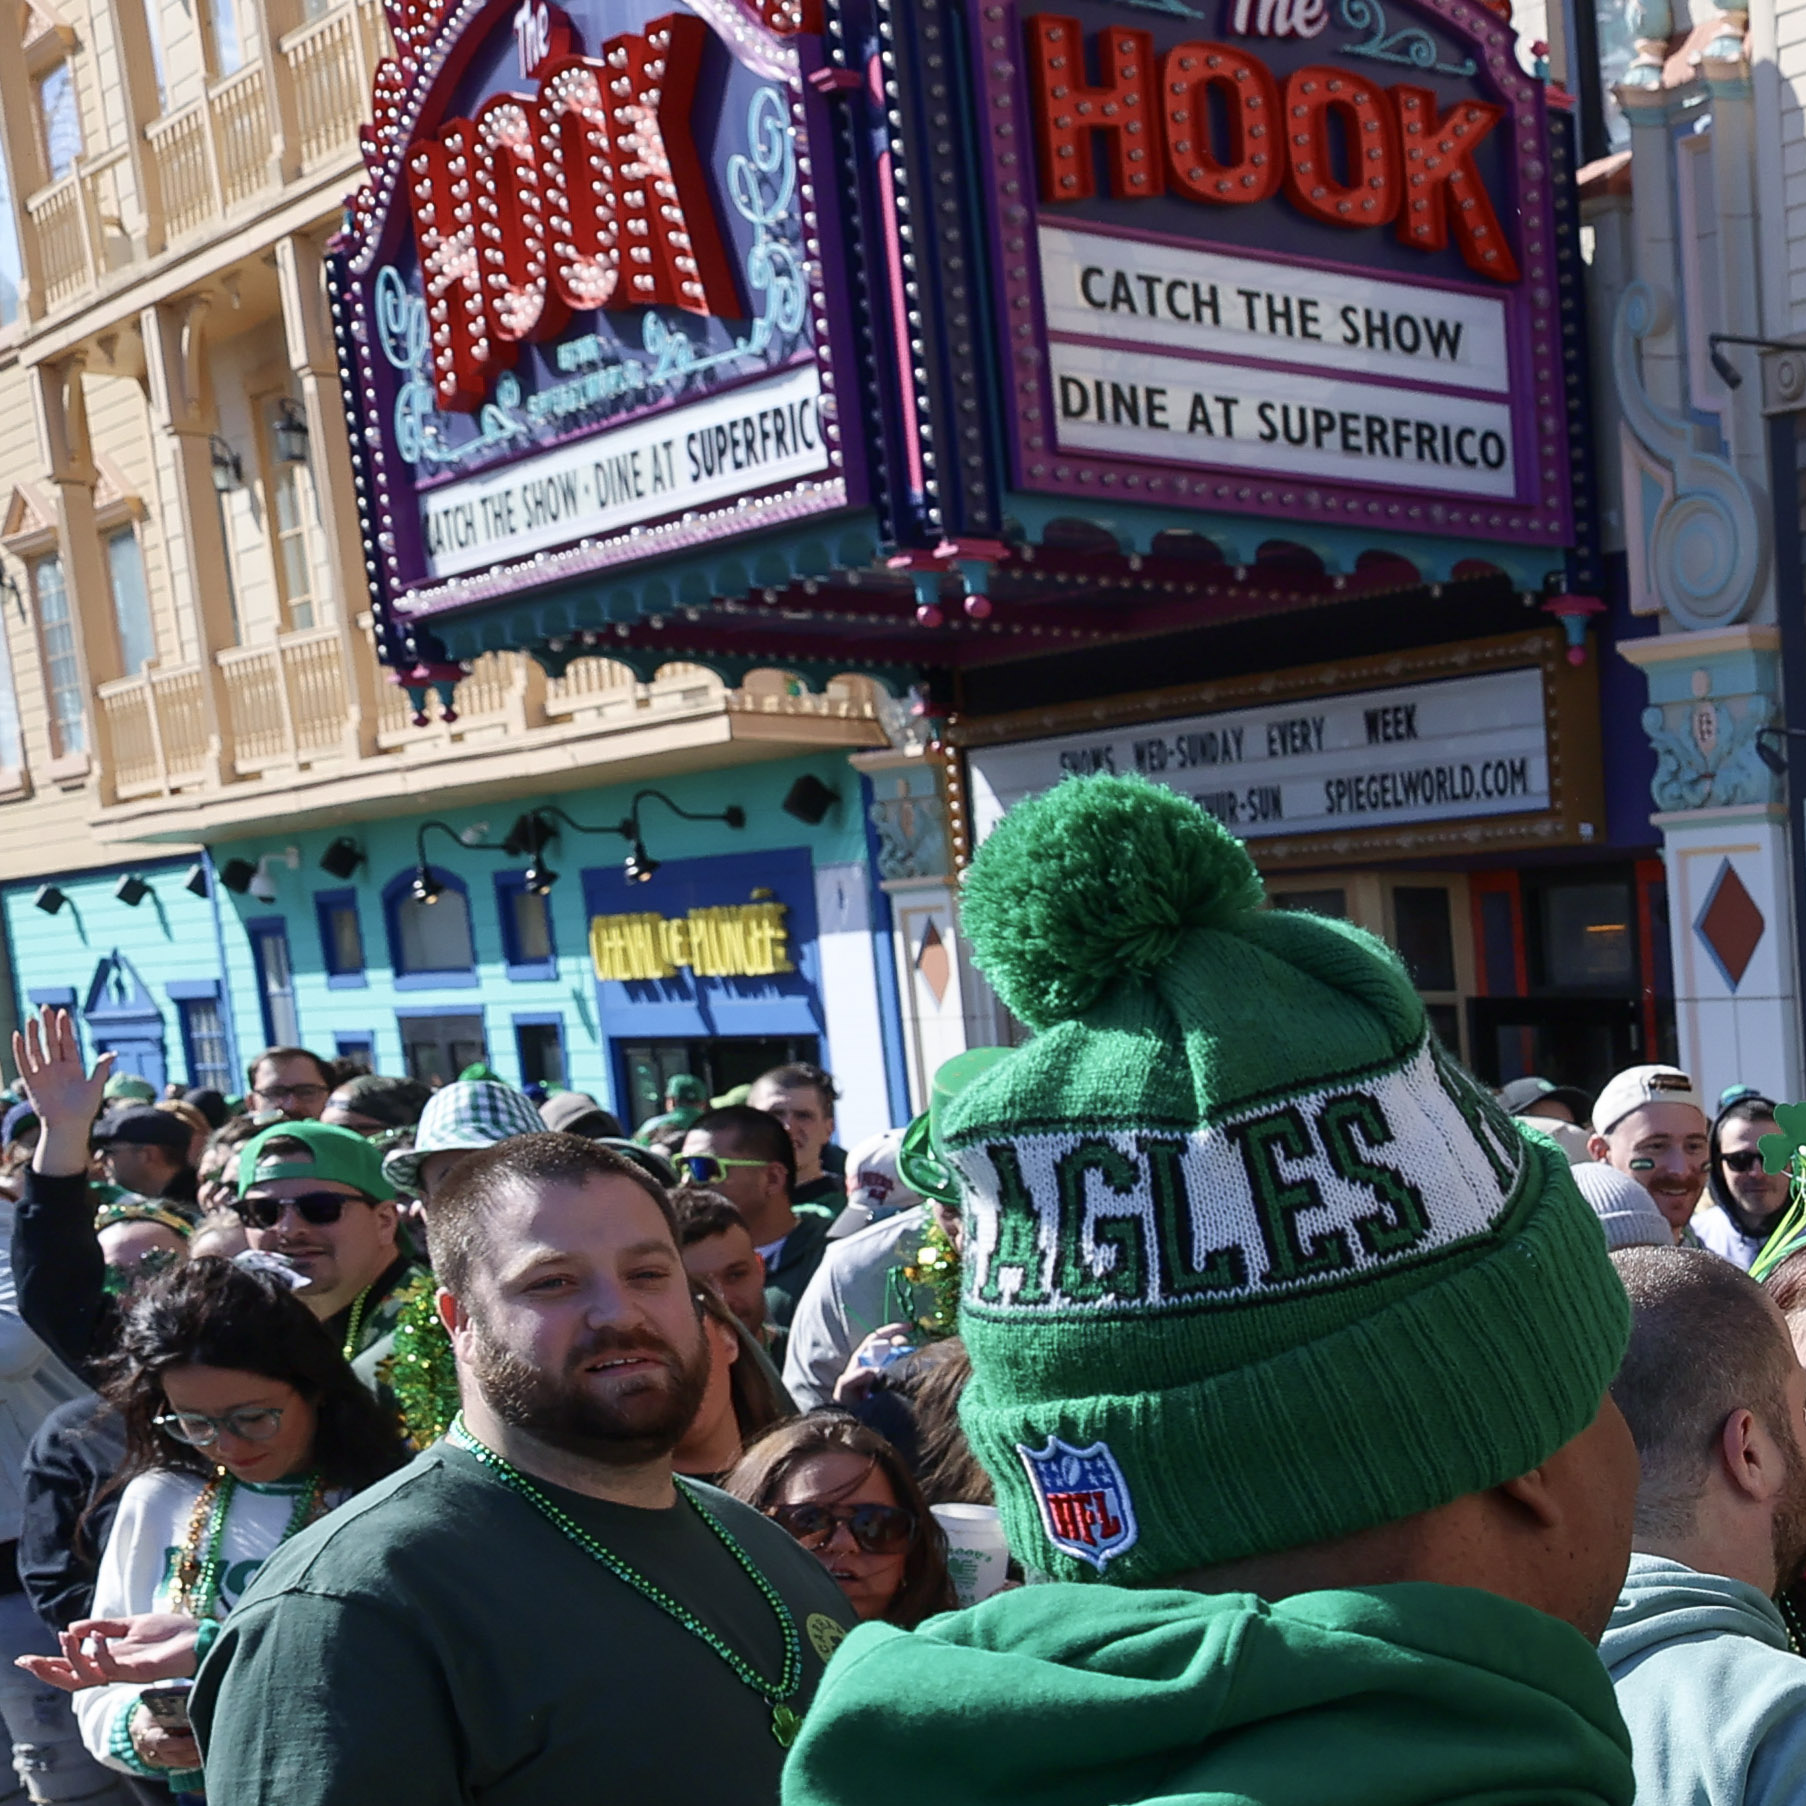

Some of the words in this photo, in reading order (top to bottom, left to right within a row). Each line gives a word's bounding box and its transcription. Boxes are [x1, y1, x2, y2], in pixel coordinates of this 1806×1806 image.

[1027, 13, 1520, 282] HOOK
[406, 14, 712, 411] HOOK
[1079, 266, 1221, 329] CATCH
[1236, 289, 1320, 342] THE
[1341, 305, 1465, 362] SHOW
[1059, 375, 1170, 431] DINE
[1187, 394, 1240, 438] AT
[1258, 402, 1508, 470] SUPERFRICO
[481, 487, 517, 536] THE
[523, 471, 580, 532] SHOW
[595, 449, 643, 508] DINE
[650, 441, 678, 495] AT
[1132, 727, 1244, 774] WED-SUNDAY
[1267, 716, 1325, 758] EVERY
[1364, 703, 1420, 745] WEEK
[1195, 785, 1283, 823] UR-SUN
[1324, 758, 1527, 815] SPIEGELWORLD.COM
[975, 1092, 1432, 1304] AGLES
[1046, 1490, 1121, 1547] NFL
